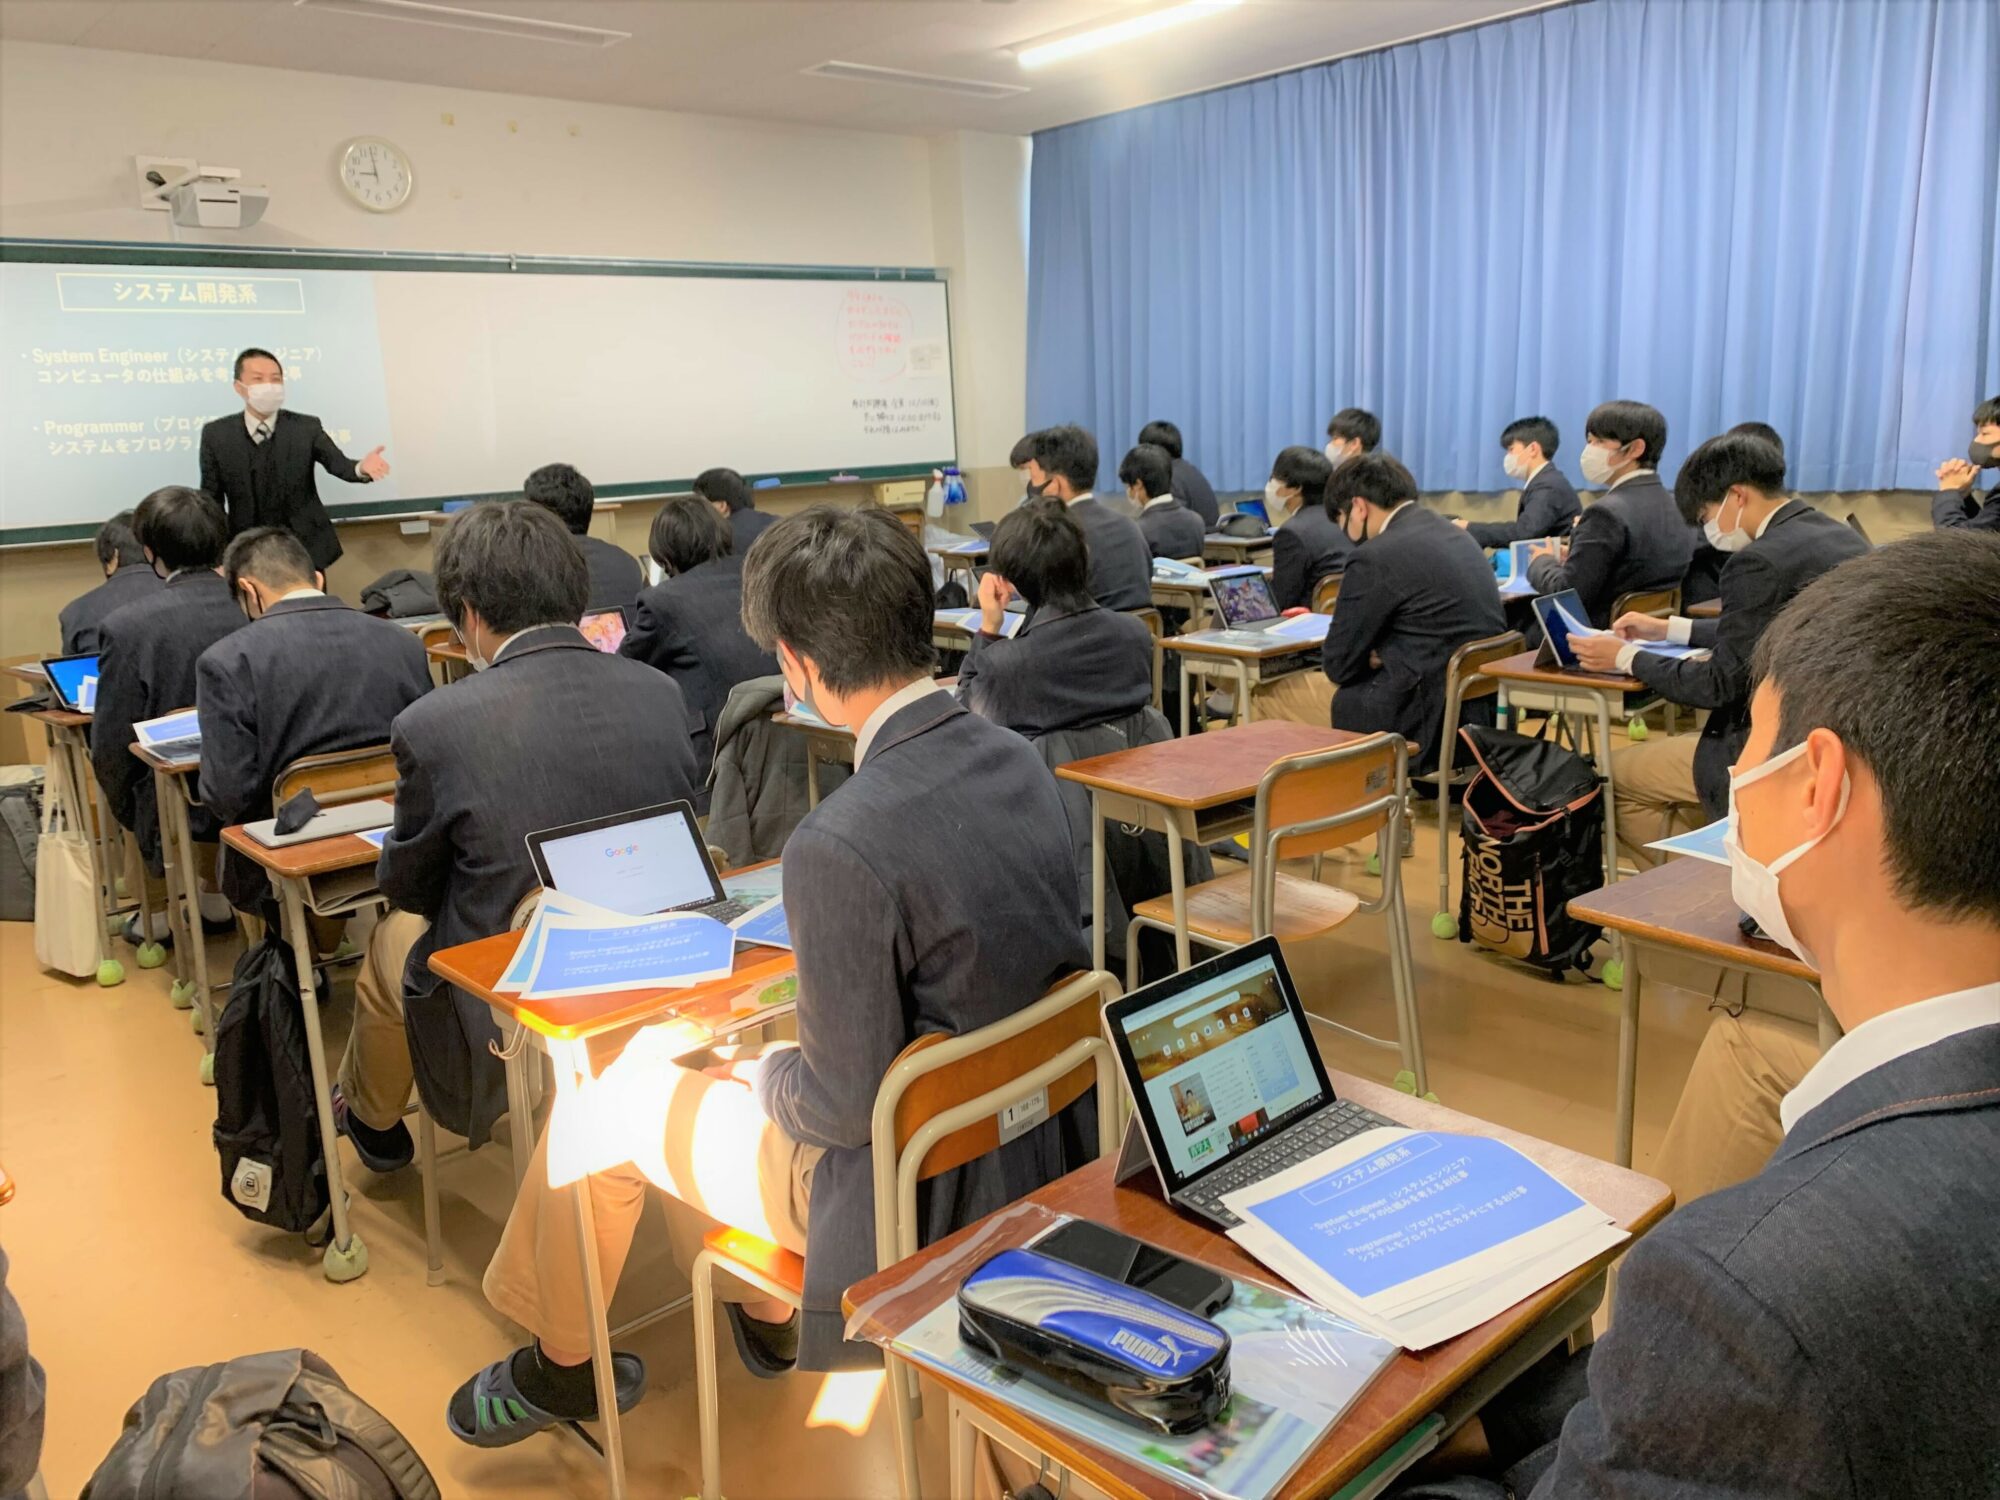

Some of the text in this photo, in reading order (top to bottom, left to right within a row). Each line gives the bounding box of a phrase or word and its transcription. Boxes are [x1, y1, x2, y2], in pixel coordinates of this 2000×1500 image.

[113, 281, 258, 304] システム開発系
[32, 347, 95, 366] System
[99, 347, 169, 366] Engineer
[44, 420, 145, 438] Programmer
[605, 843, 639, 858] Google
[1478, 840, 1507, 926] NORTH
[1503, 878, 1534, 929] THE
[1110, 1327, 1171, 1367] PUMA
